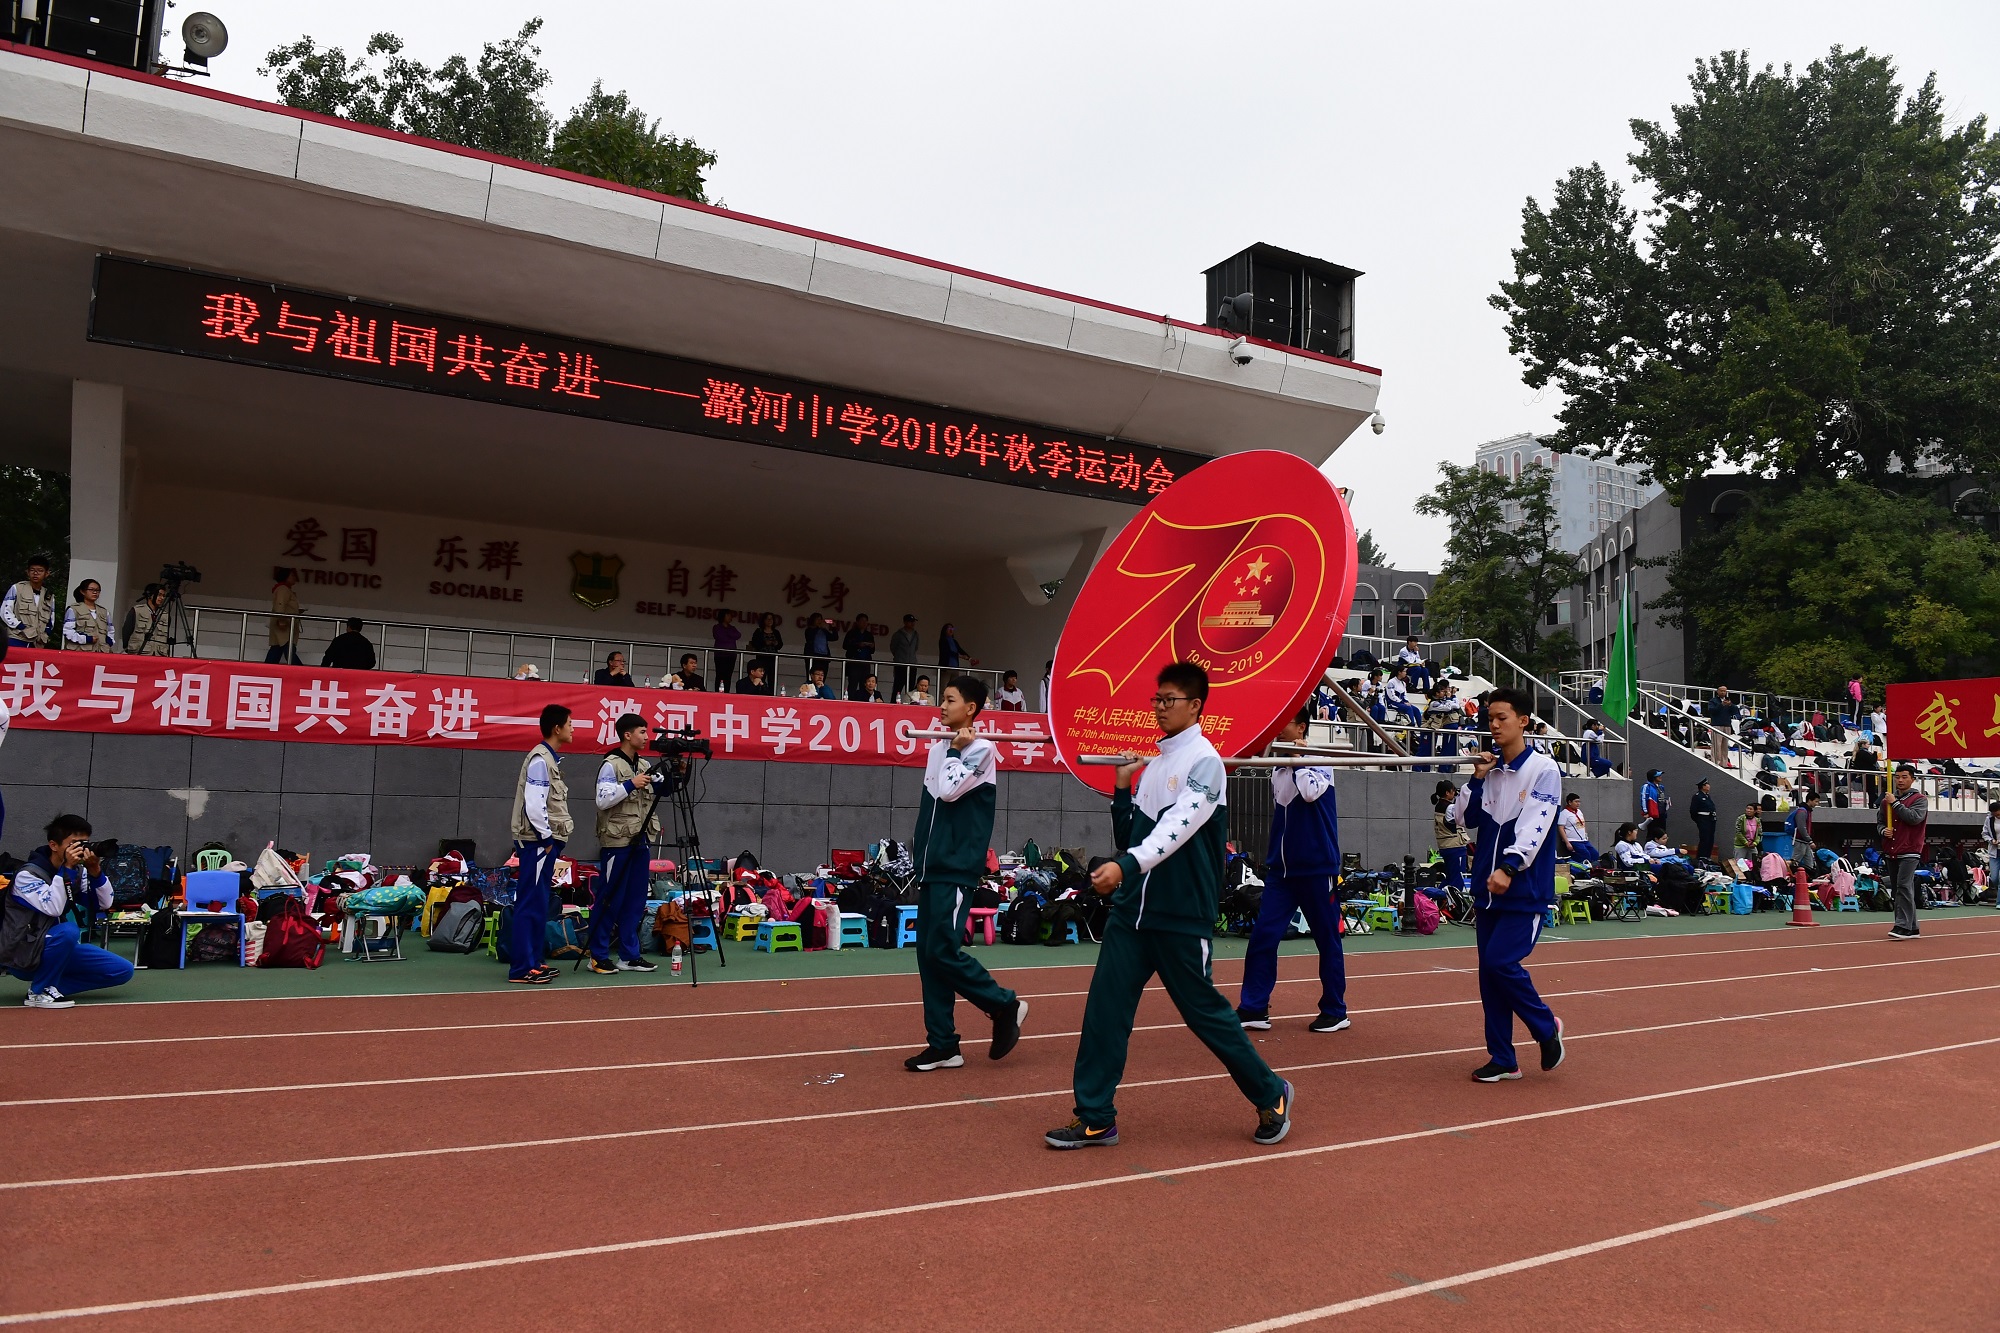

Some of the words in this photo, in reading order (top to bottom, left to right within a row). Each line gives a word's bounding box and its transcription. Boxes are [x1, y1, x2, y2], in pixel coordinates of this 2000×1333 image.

[282, 517, 378, 566] 爱国
[433, 535, 523, 580] 乐群
[667, 559, 739, 602] 自律
[782, 574, 850, 613] 修身
[429, 580, 524, 602] SOCIABLE
[1066, 728, 1081, 738] The
[1081, 728, 1098, 739] 70th
[1098, 731, 1145, 746] Anniversary
[1145, 734, 1156, 744] of
[1076, 742, 1091, 752] The
